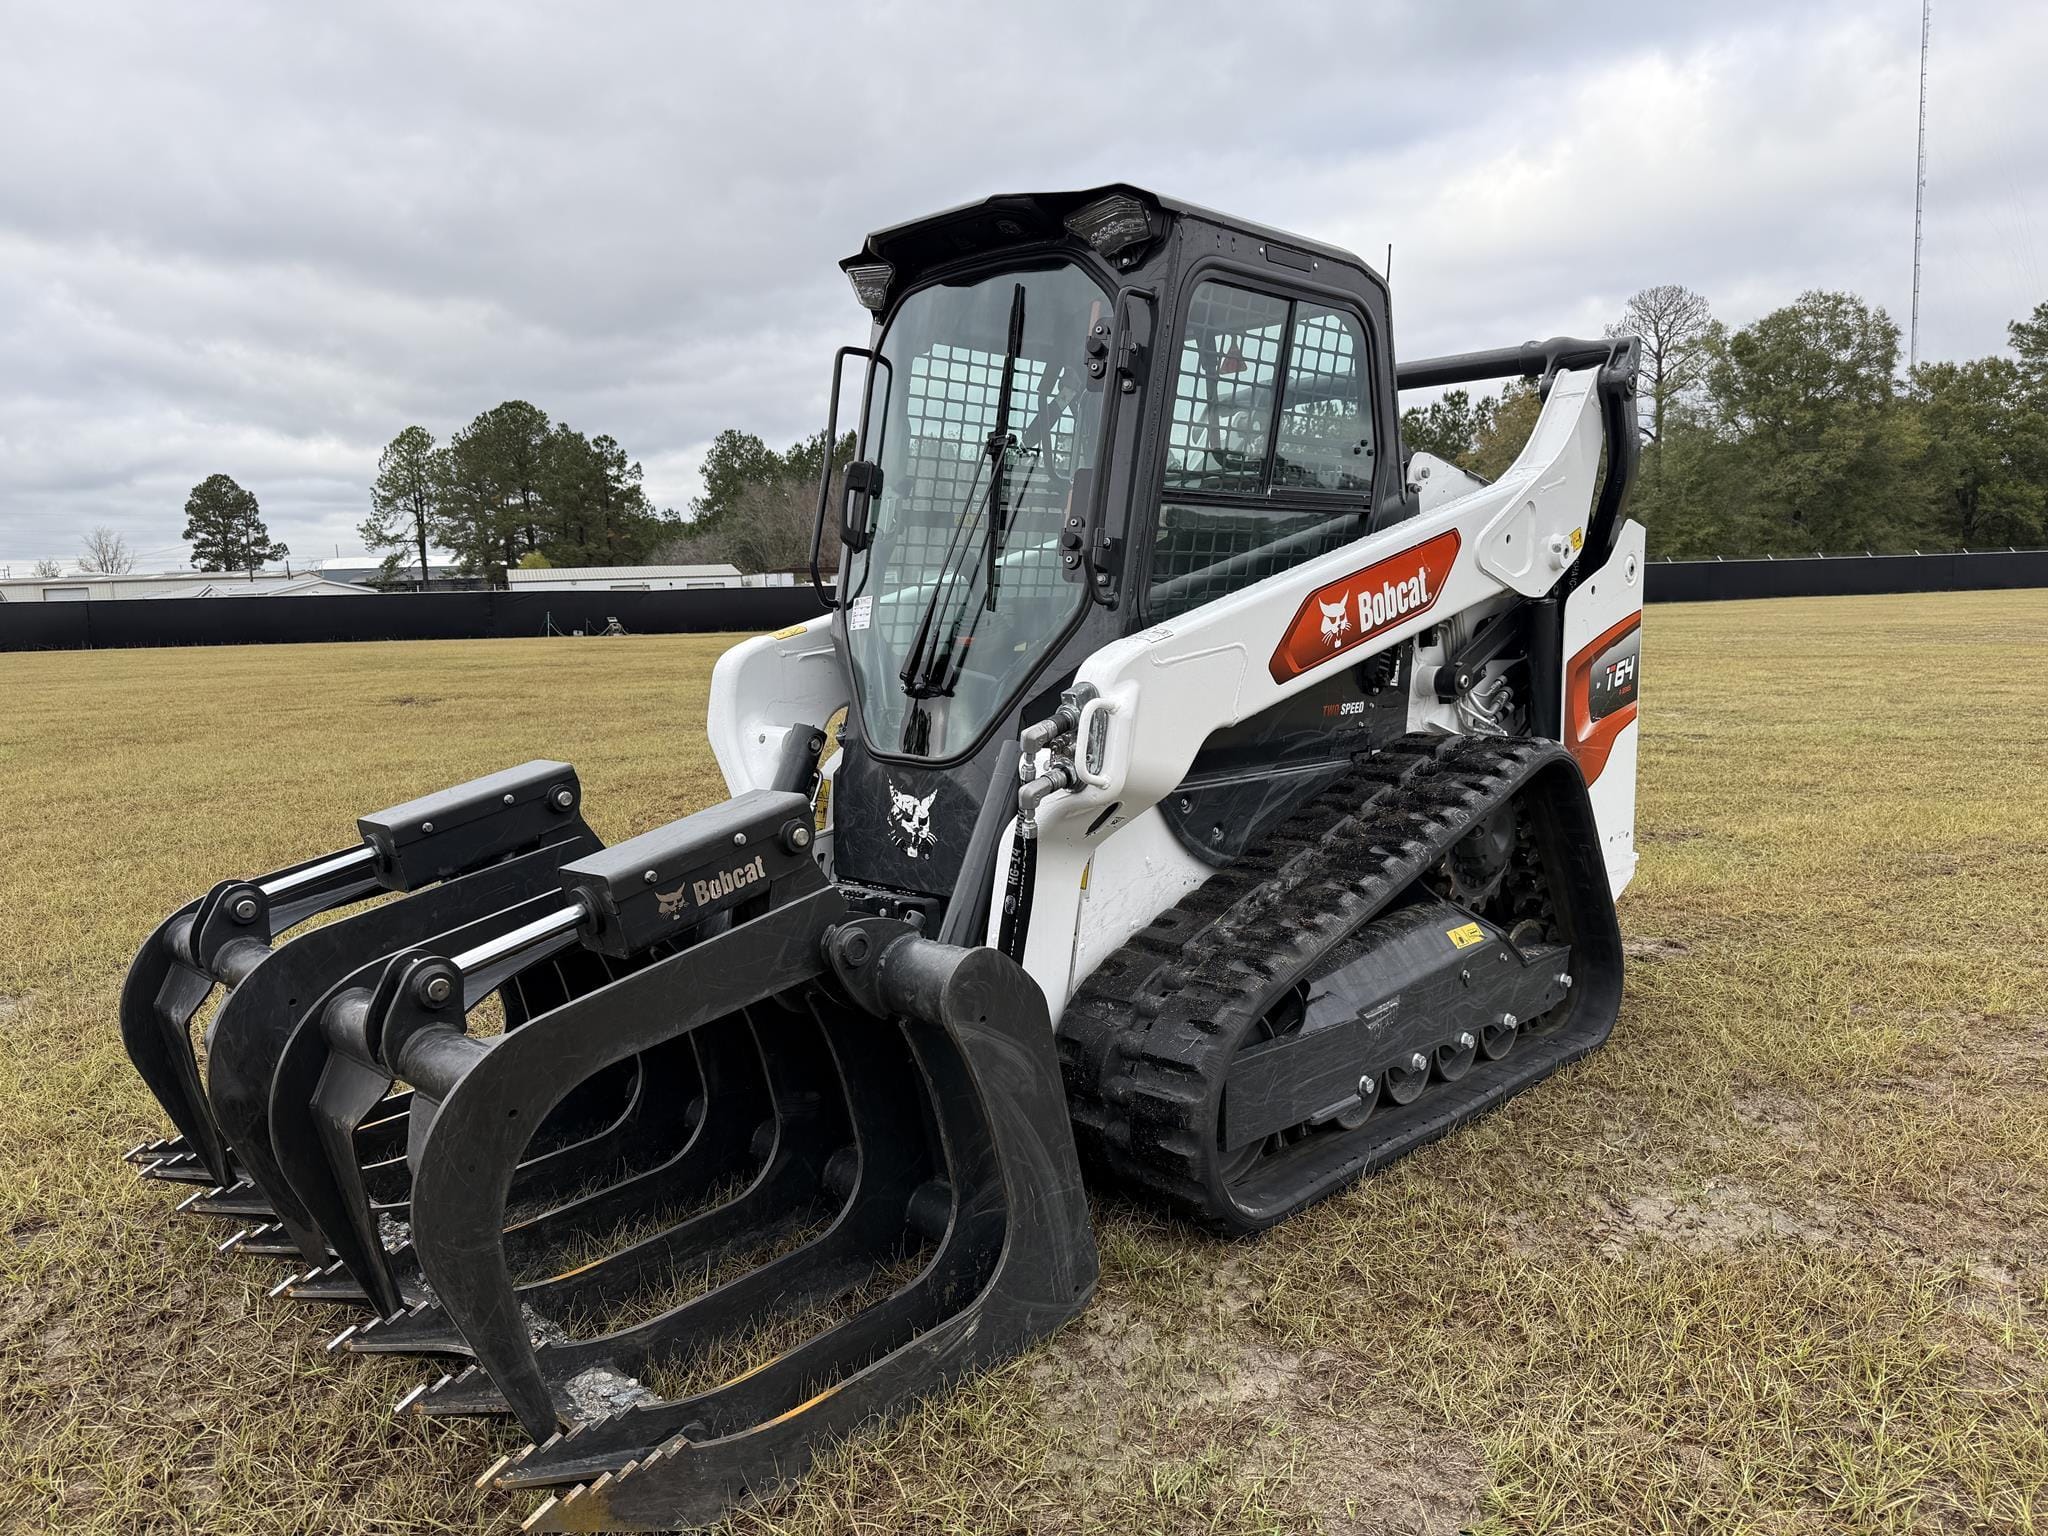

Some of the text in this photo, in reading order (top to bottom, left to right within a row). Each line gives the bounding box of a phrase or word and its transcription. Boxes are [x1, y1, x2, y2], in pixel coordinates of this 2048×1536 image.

[1358, 566, 1428, 633] Bobcat
[1323, 701, 1365, 716] TWO SPEED
[693, 855, 766, 907] Bobcat
[1008, 848, 1021, 885] HG-14
